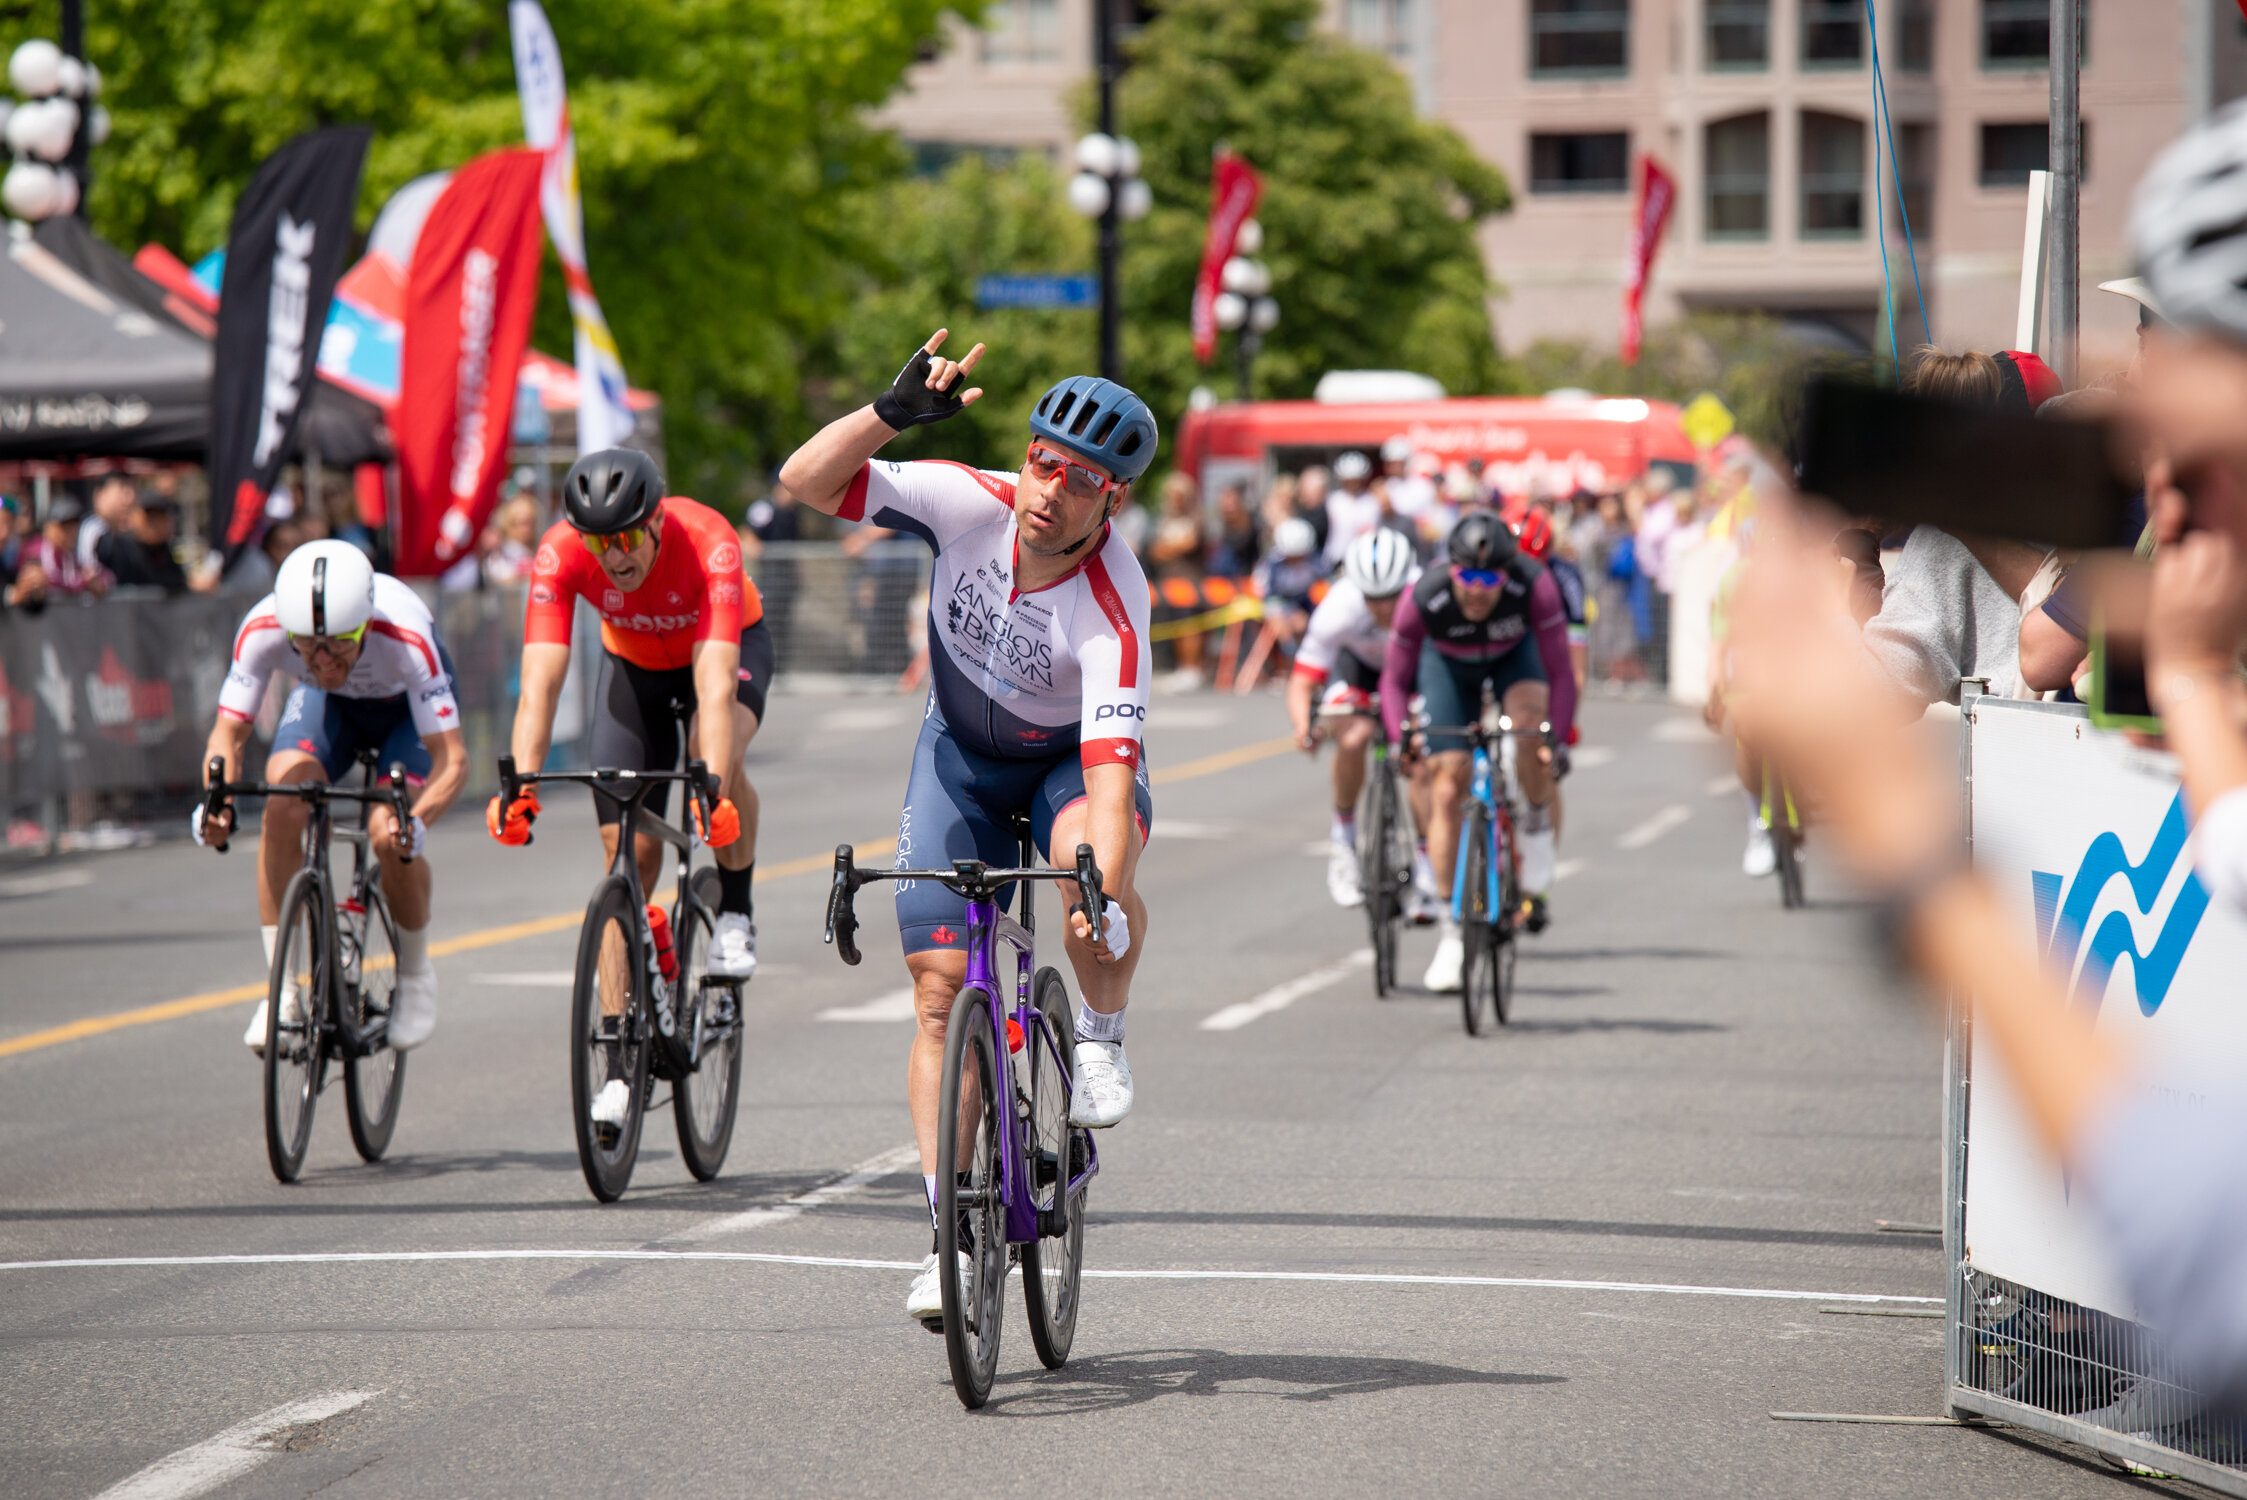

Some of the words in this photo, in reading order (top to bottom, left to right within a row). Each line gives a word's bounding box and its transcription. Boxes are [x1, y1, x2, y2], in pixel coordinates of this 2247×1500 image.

[953, 571, 1052, 669] LANGLOIS
[962, 610, 1053, 688] BROWN
[1020, 612, 1048, 629] PRECISION
